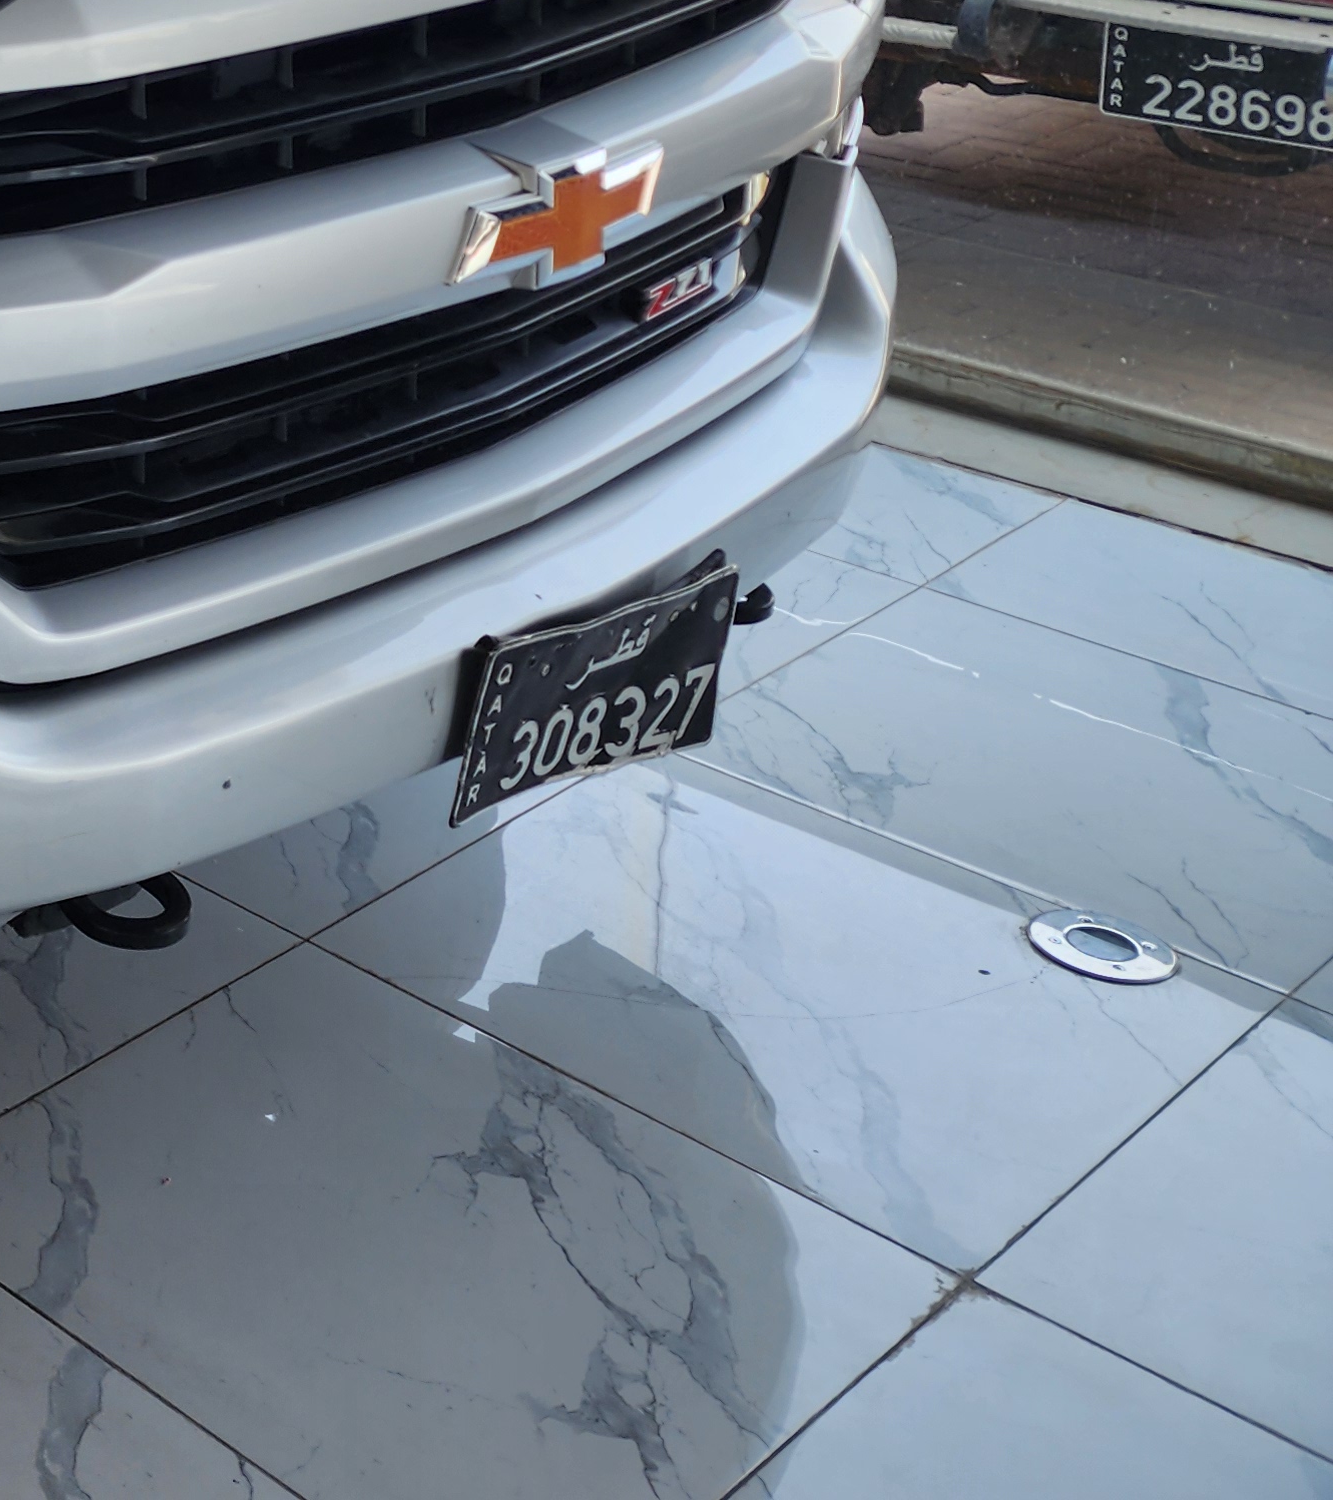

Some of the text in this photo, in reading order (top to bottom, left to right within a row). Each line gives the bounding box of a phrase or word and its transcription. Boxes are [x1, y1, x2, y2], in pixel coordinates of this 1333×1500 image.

[1109, 27, 1129, 108] QATAR
[1189, 44, 1265, 73] قطر
[1142, 73, 1333, 142] 228698
[646, 257, 713, 321] Z71
[565, 613, 658, 690] قطر
[465, 662, 513, 807] QATAR
[499, 663, 716, 791] 308327
